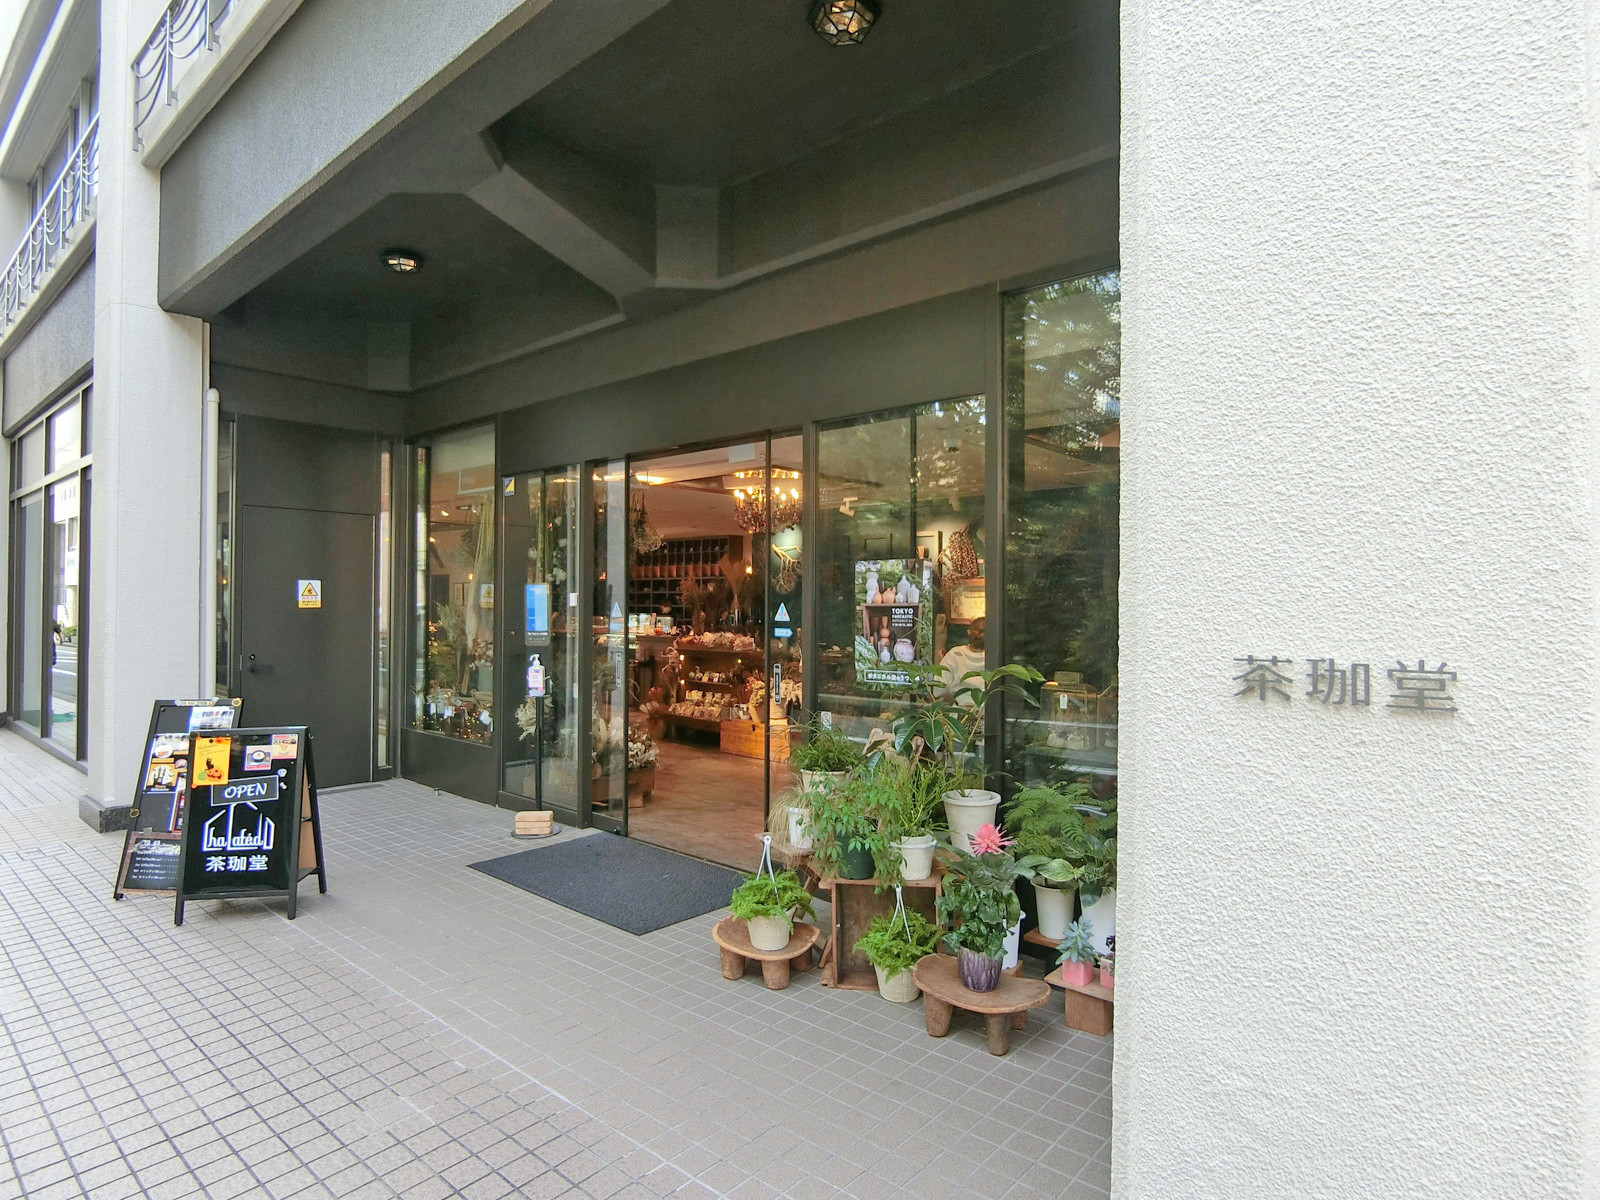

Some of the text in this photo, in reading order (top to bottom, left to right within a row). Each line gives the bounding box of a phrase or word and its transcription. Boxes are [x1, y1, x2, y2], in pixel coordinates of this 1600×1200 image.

[891, 607, 914, 615] TOKYO
[1232, 654, 1459, 712] 茶珈堂
[224, 782, 268, 799] OPEN
[205, 854, 269, 873] 茶珈堂
